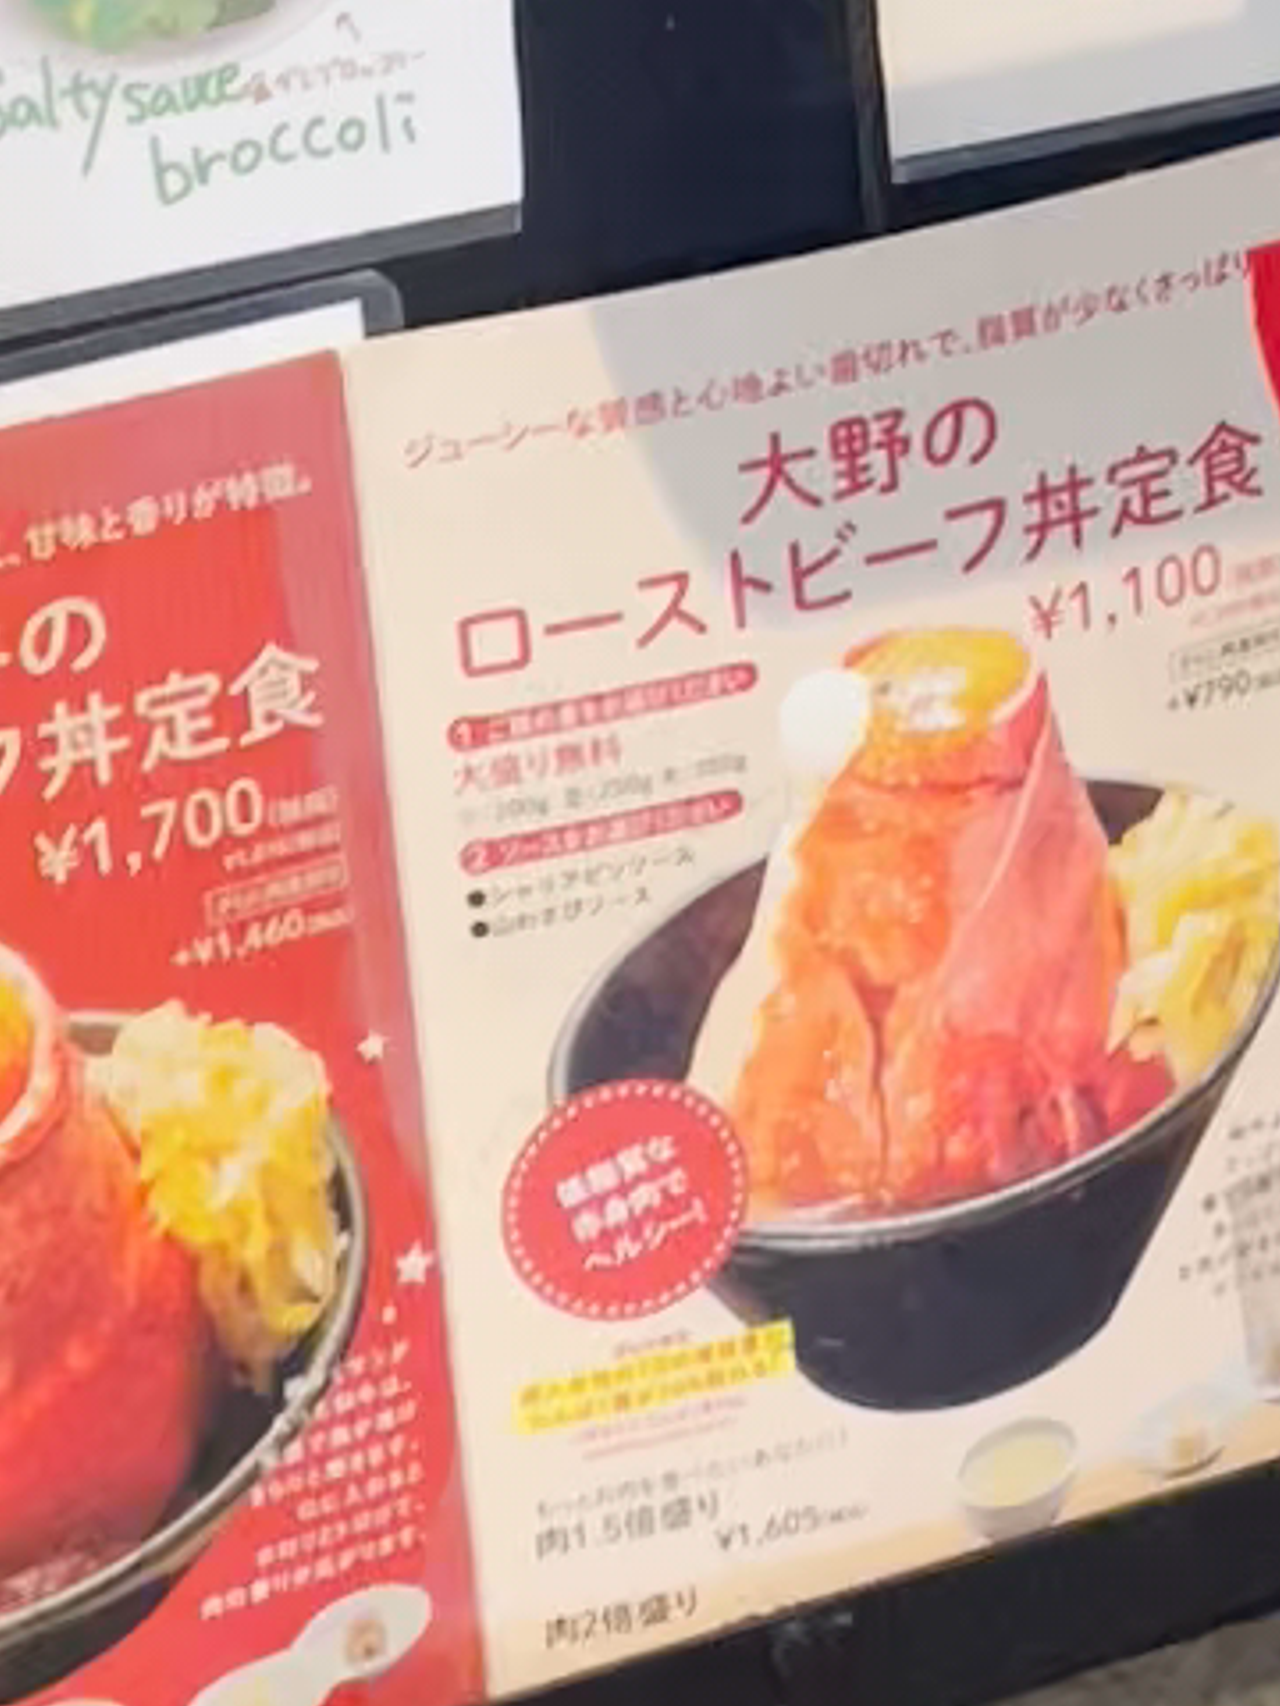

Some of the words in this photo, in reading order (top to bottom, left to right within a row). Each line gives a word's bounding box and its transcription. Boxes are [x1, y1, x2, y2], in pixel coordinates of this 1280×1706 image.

[126, 60, 246, 126] sauce
[151, 91, 416, 206] broccoli
[738, 397, 999, 525] 大野の
[457, 418, 1266, 679] ローストビーフ丼定食
[1029, 542, 1222, 642] ¥1,100
[35, 777, 264, 884] ¥1,700
